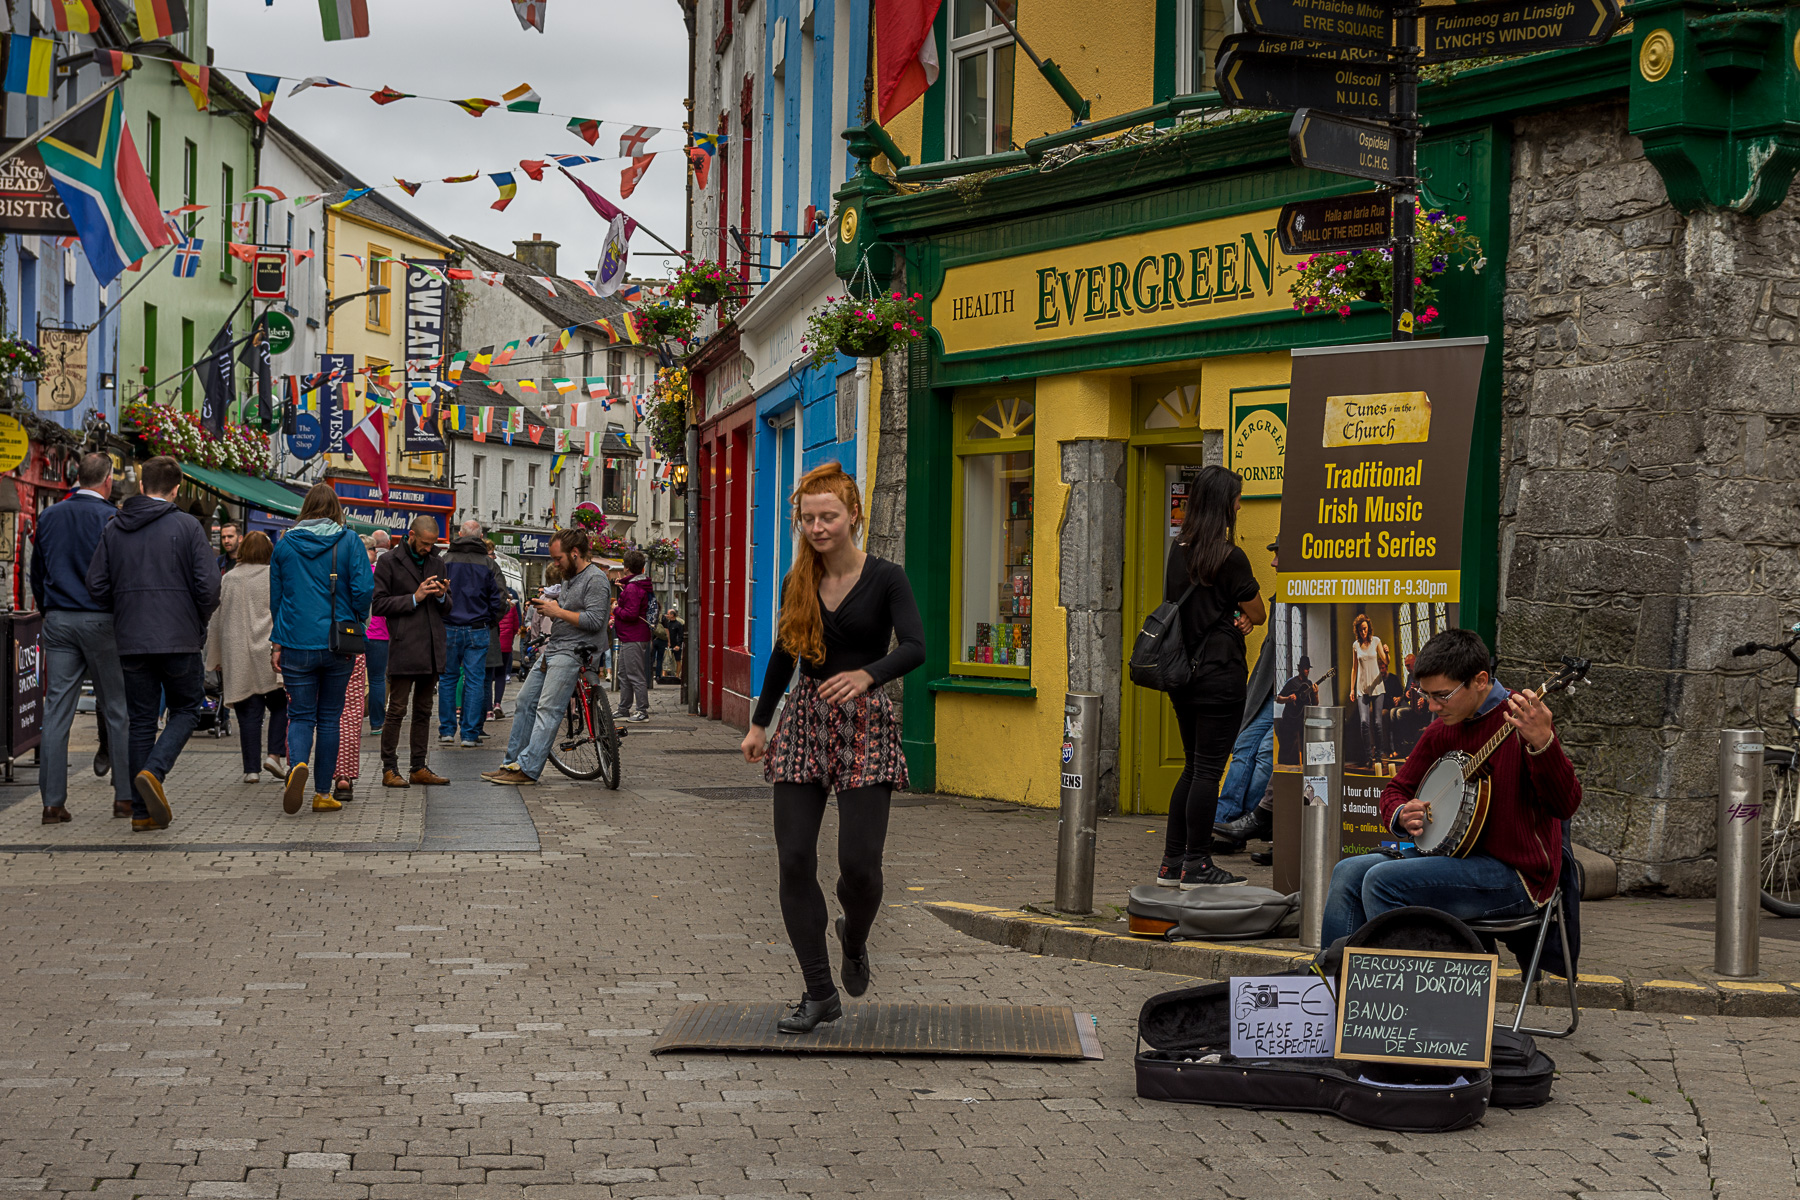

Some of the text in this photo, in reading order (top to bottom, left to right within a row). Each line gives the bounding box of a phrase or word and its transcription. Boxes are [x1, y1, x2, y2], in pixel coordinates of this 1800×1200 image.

[1356, 3, 1384, 19] Mhór
[1436, 3, 1575, 30] Fuinneog an Linsigh
[1303, 15, 1384, 39] EYRE SQUARE
[1290, 40, 1304, 50] na
[1435, 23, 1563, 50] LYNCH'S WINDOW
[1335, 70, 1381, 87] Ollscoil
[1336, 90, 1381, 107] N.U.I.G.
[1359, 132, 1390, 151] Ospidéal
[10, 157, 25, 166] The
[1360, 152, 1389, 170] U.C.H.G.
[1325, 204, 1385, 222] Halla an Iarla Rua
[1302, 222, 1385, 242] HALL OF THE RED EARL
[952, 228, 1277, 330] HEALTH EVERGREEN
[268, 328, 290, 338] lsberg
[1344, 401, 1387, 417] Tunes
[1343, 418, 1396, 442] Church
[296, 441, 312, 449] Shop
[1235, 420, 1285, 459] EVERGREEN
[1324, 459, 1423, 489] Traditional
[1318, 495, 1423, 524] Irish Music
[1301, 530, 1437, 560] Concert Series
[1287, 578, 1448, 598] CONCERT TONIGHT 8-9.30pm
[1347, 785, 1362, 797] tour
[1364, 787, 1371, 798] of
[1349, 802, 1376, 816] dancing
[1360, 822, 1378, 833] online
[1352, 955, 1437, 974] PERCUSSIVE
[1348, 972, 1404, 992] ANETA
[1347, 1000, 1409, 1021] BANJO:
[1238, 1022, 1324, 1040] PLEASE BE
[1255, 1039, 1329, 1056] RESPECTFUL
[1385, 1040, 1469, 1056] DE SIMONE
